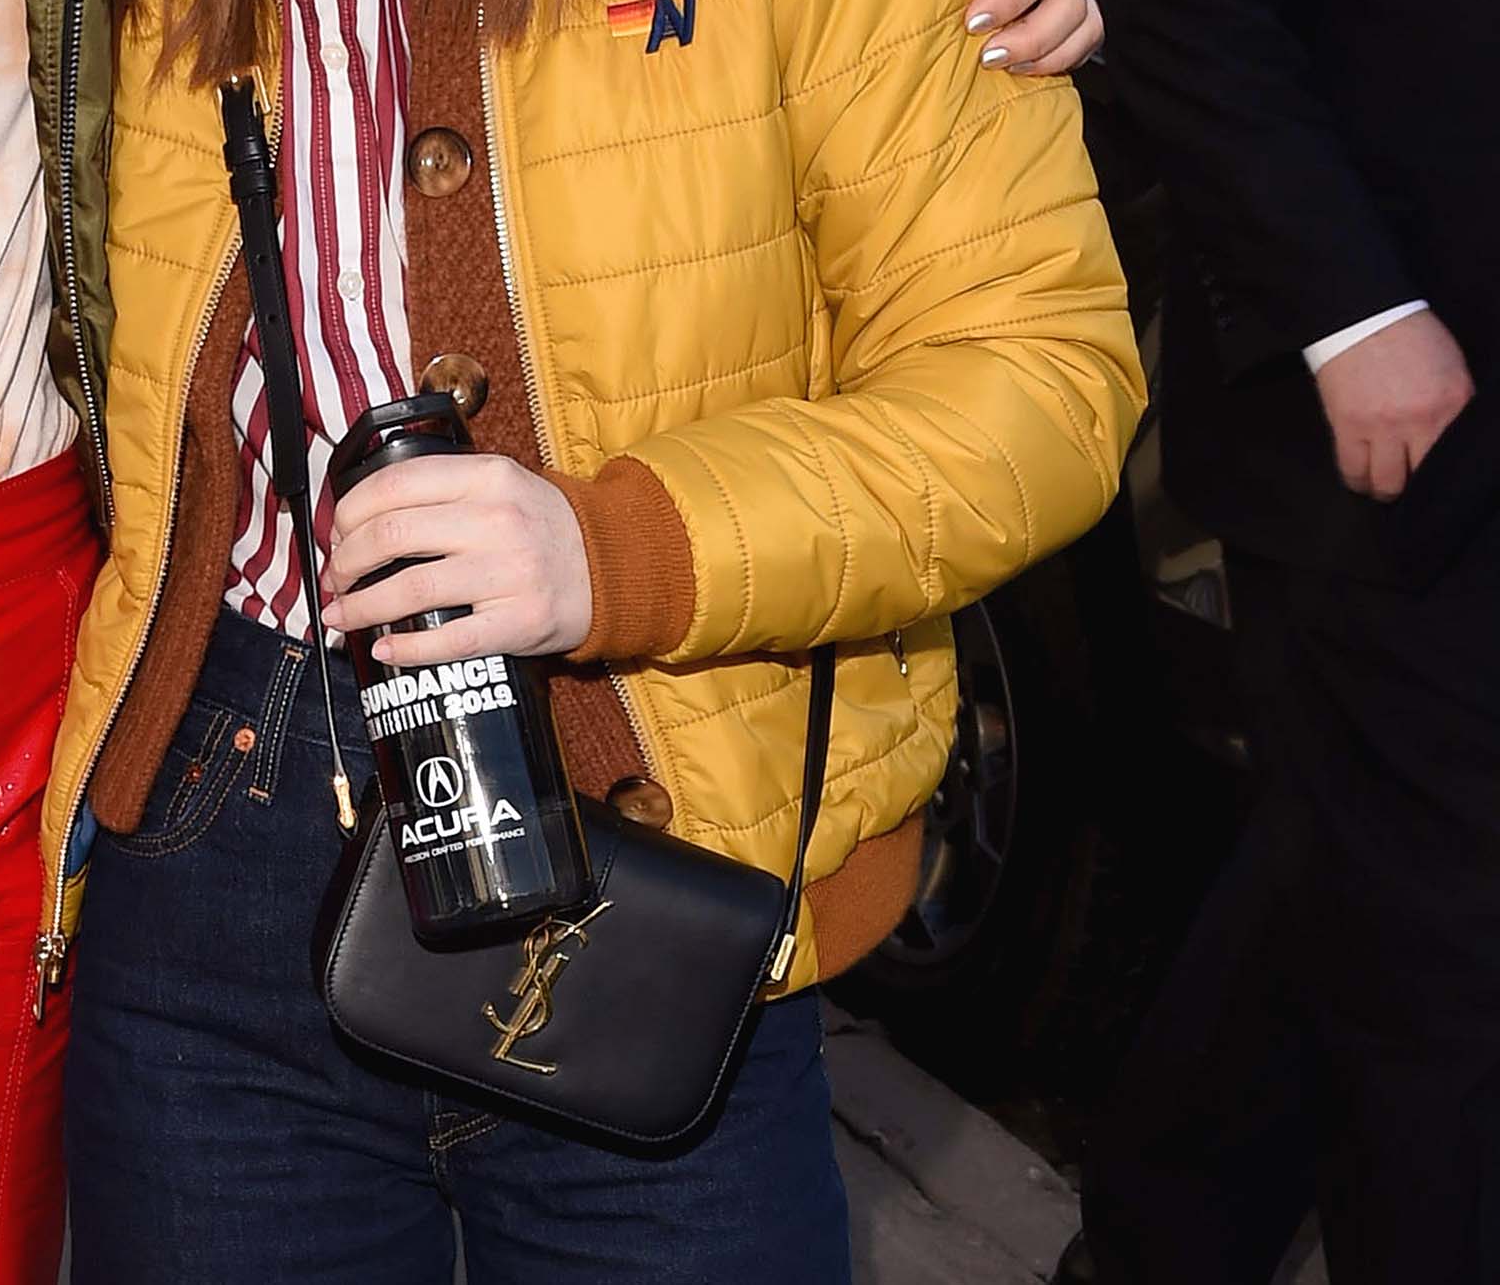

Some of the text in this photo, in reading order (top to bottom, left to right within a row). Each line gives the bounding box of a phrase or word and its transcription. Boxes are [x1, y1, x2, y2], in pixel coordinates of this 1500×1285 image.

[360, 656, 508, 718] SUNDANCE
[382, 699, 442, 737] FESTIVAL
[402, 798, 523, 849] ACURA
